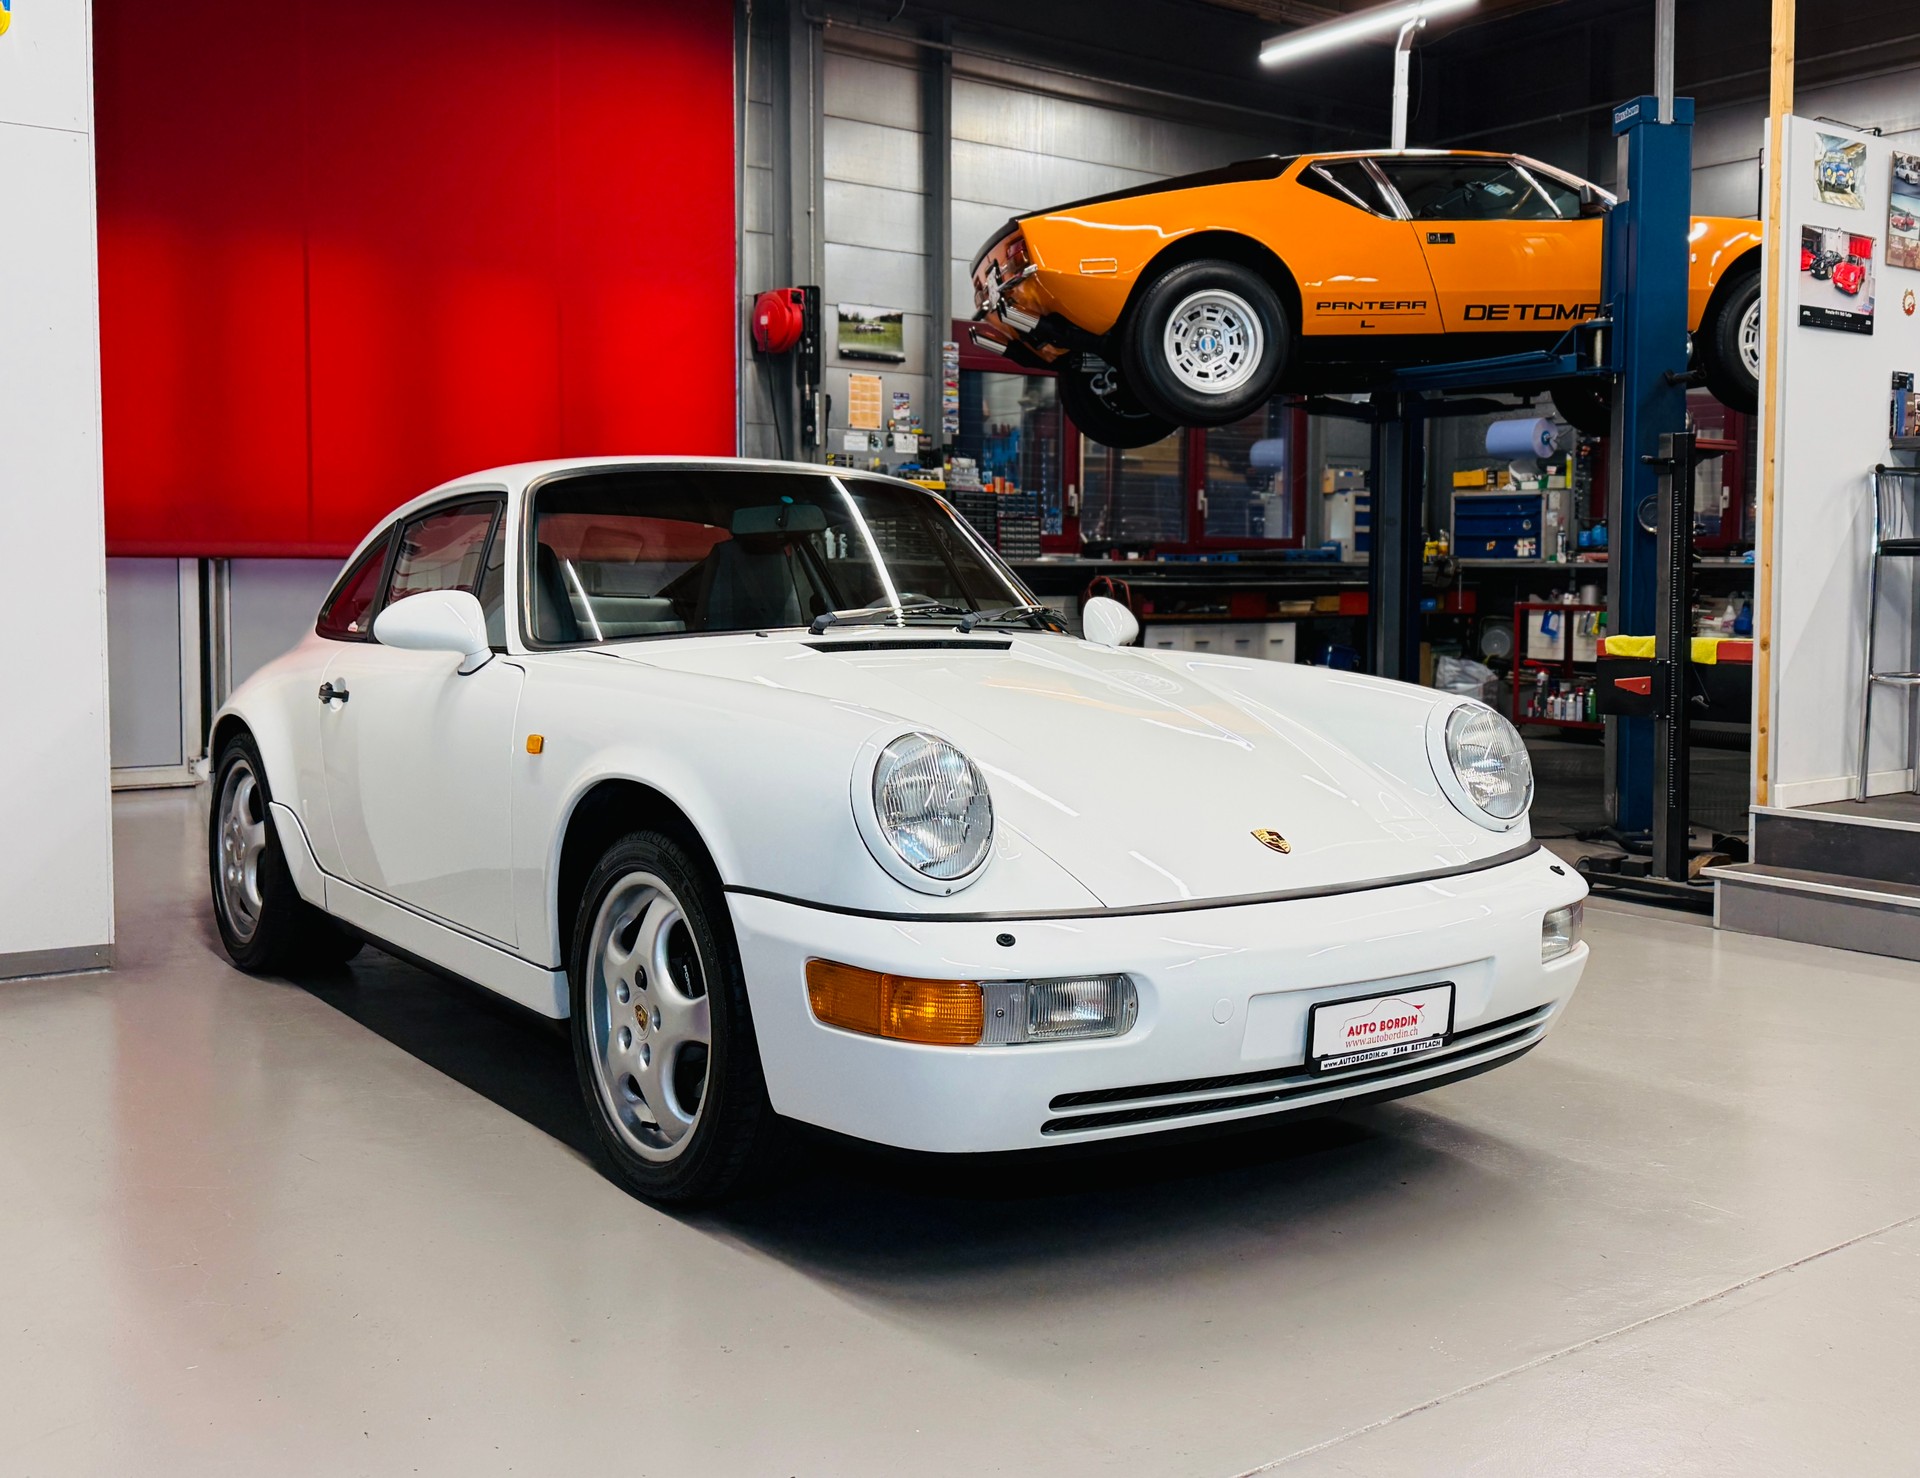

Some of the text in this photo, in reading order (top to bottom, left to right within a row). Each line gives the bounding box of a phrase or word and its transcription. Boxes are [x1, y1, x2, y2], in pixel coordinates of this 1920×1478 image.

[1316, 301, 1427, 310] PANTERA
[1464, 303, 1601, 320] DE TOMA
[1361, 320, 1375, 328] L
[1347, 1014, 1418, 1037] AUTO BORDIN
[1345, 1026, 1419, 1048] www.autobordin.ch
[1411, 1040, 1441, 1051] BETTLACH
